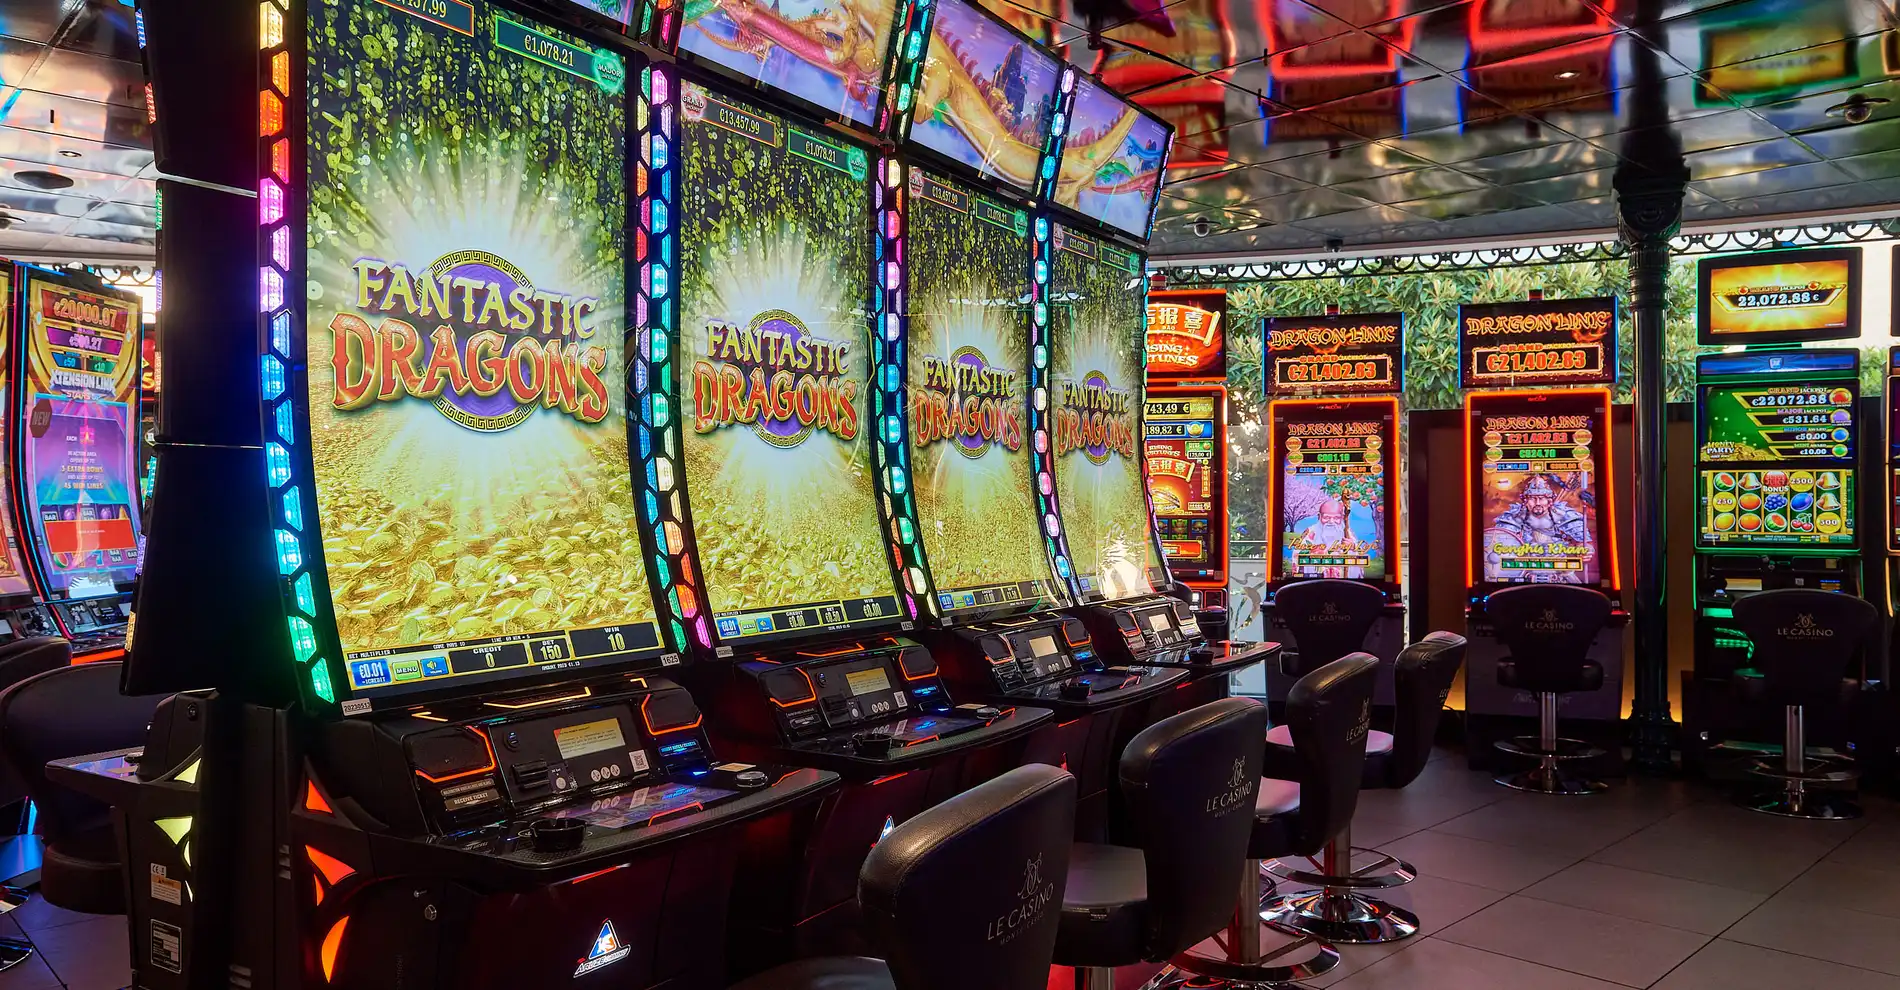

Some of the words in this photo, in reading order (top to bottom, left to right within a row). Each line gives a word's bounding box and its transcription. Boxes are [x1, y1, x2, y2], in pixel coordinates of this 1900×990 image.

[523, 33, 574, 67] €1,078.21
[597, 63, 621, 78] MAJOR
[682, 95, 704, 108] GRAND
[719, 108, 760, 135] €13,457.99
[352, 257, 599, 340] FANTASTIC
[1738, 292, 1811, 307] 22,072.88
[1466, 314, 1553, 336] DRAGON
[1555, 311, 1607, 331] LINK
[1270, 326, 1347, 347] DRAGON
[1349, 325, 1396, 344] LINK
[705, 318, 851, 375] FANTASTIC
[1499, 343, 1543, 352] GRAND
[1299, 354, 1339, 363] GRAND
[1486, 350, 1586, 372] €21,402.83
[328, 312, 610, 423] DRAGONS
[1287, 361, 1377, 381] €21,402.83
[922, 355, 1017, 398] FANTASTIC
[692, 361, 858, 440] DRAGONS
[1061, 381, 1130, 413] FANTASTIC
[32, 411, 50, 426] NEW
[914, 389, 1021, 451] DRAGONS
[1485, 416, 1549, 430] DRAGON
[1783, 415, 1827, 424] €531.64
[1056, 408, 1134, 458] DRAGONS
[1287, 423, 1344, 436] DRAGON
[1763, 485, 1790, 493] BONUS
[1493, 543, 1545, 556] Genghis
[1548, 543, 1588, 555] Khan
[1539, 621, 1574, 630] CASINO
[1777, 628, 1788, 636] LE
[1790, 628, 1833, 637] CASINO
[473, 645, 502, 654] CREDIT
[607, 632, 626, 652] 10
[484, 652, 496, 668] 0
[540, 644, 563, 660] 150
[662, 655, 679, 665] 1625
[359, 661, 384, 679] €0.01
[396, 666, 418, 674] MENU
[453, 796, 472, 805] RECEIVE
[473, 792, 488, 801] TICKET
[1206, 796, 1219, 812] LE
[1220, 781, 1252, 807] CASINO
[987, 916, 1005, 940] LE
[1008, 883, 1054, 928] CASINO
